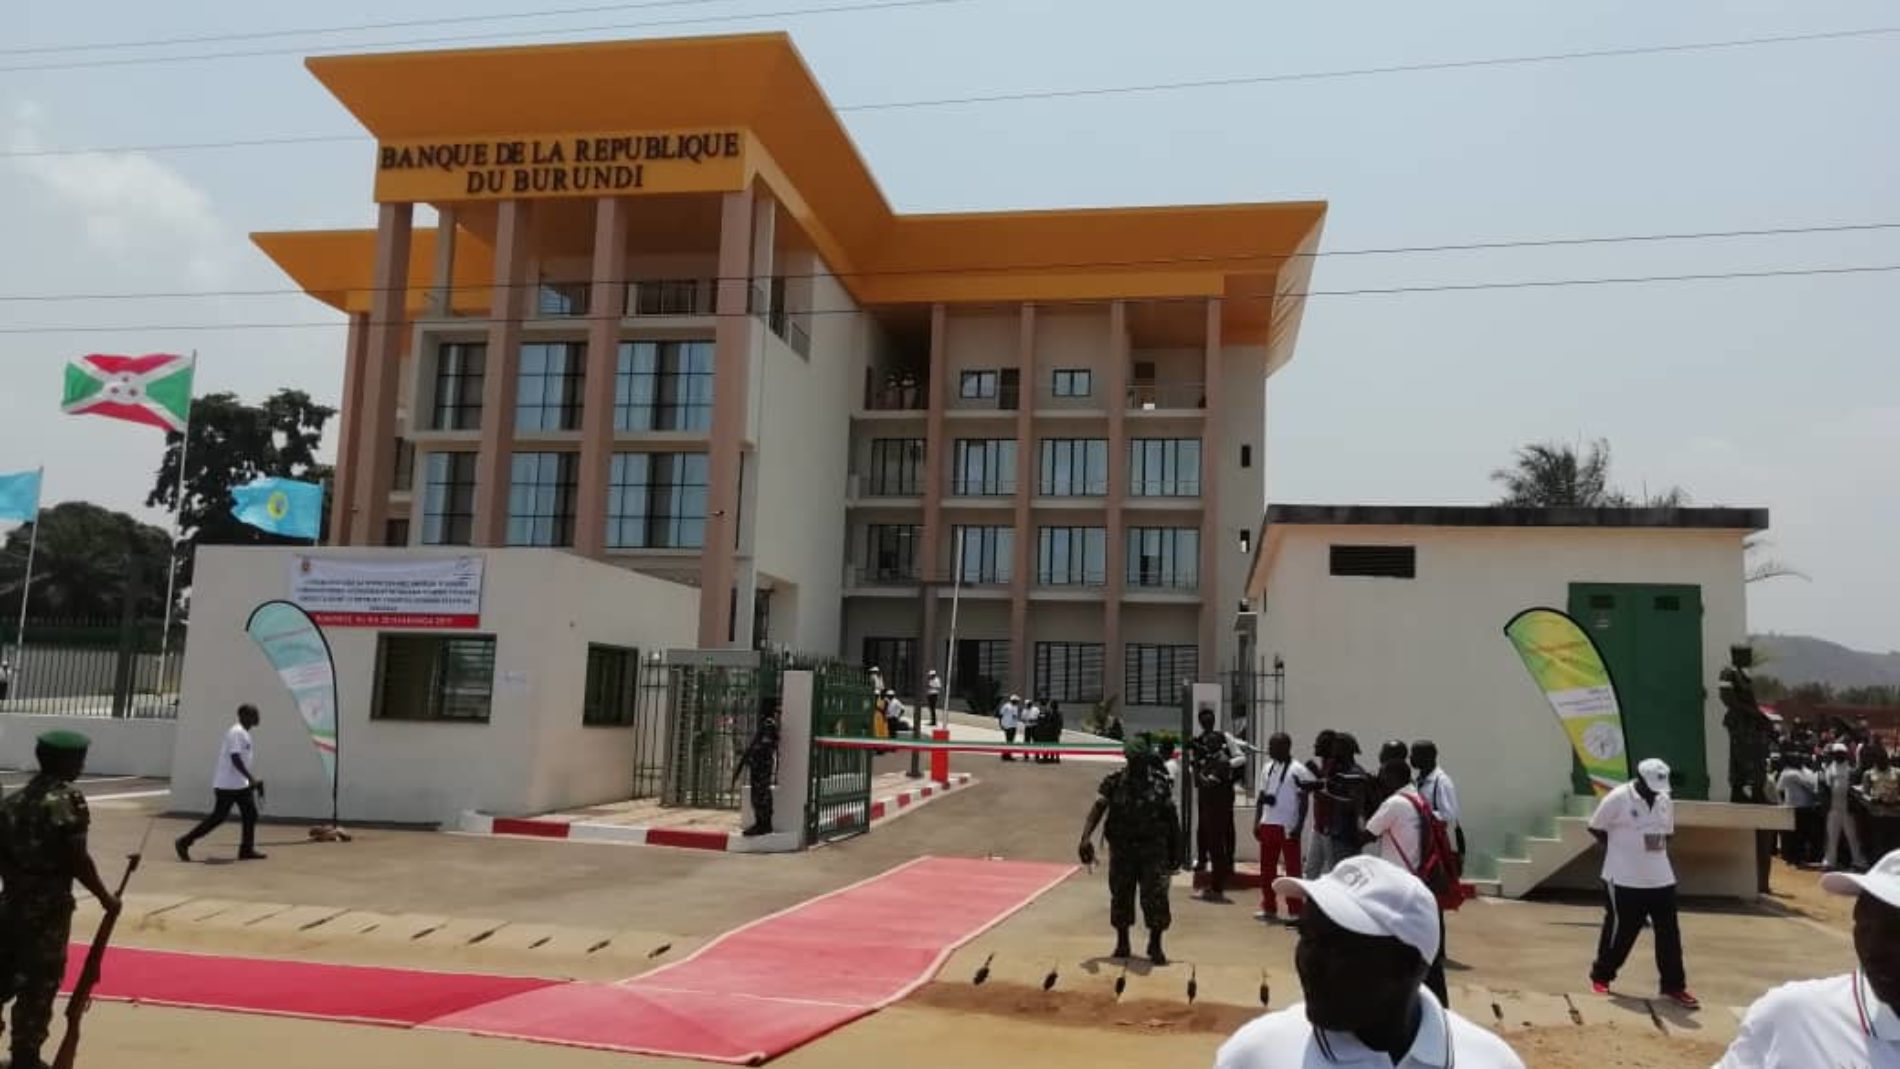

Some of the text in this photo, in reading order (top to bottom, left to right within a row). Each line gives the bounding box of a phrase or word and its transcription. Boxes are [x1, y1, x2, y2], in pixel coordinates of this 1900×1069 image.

[380, 133, 739, 172] BANQUE DE LA REPUBLIQUE
[466, 165, 644, 194] DU BURUNDI
